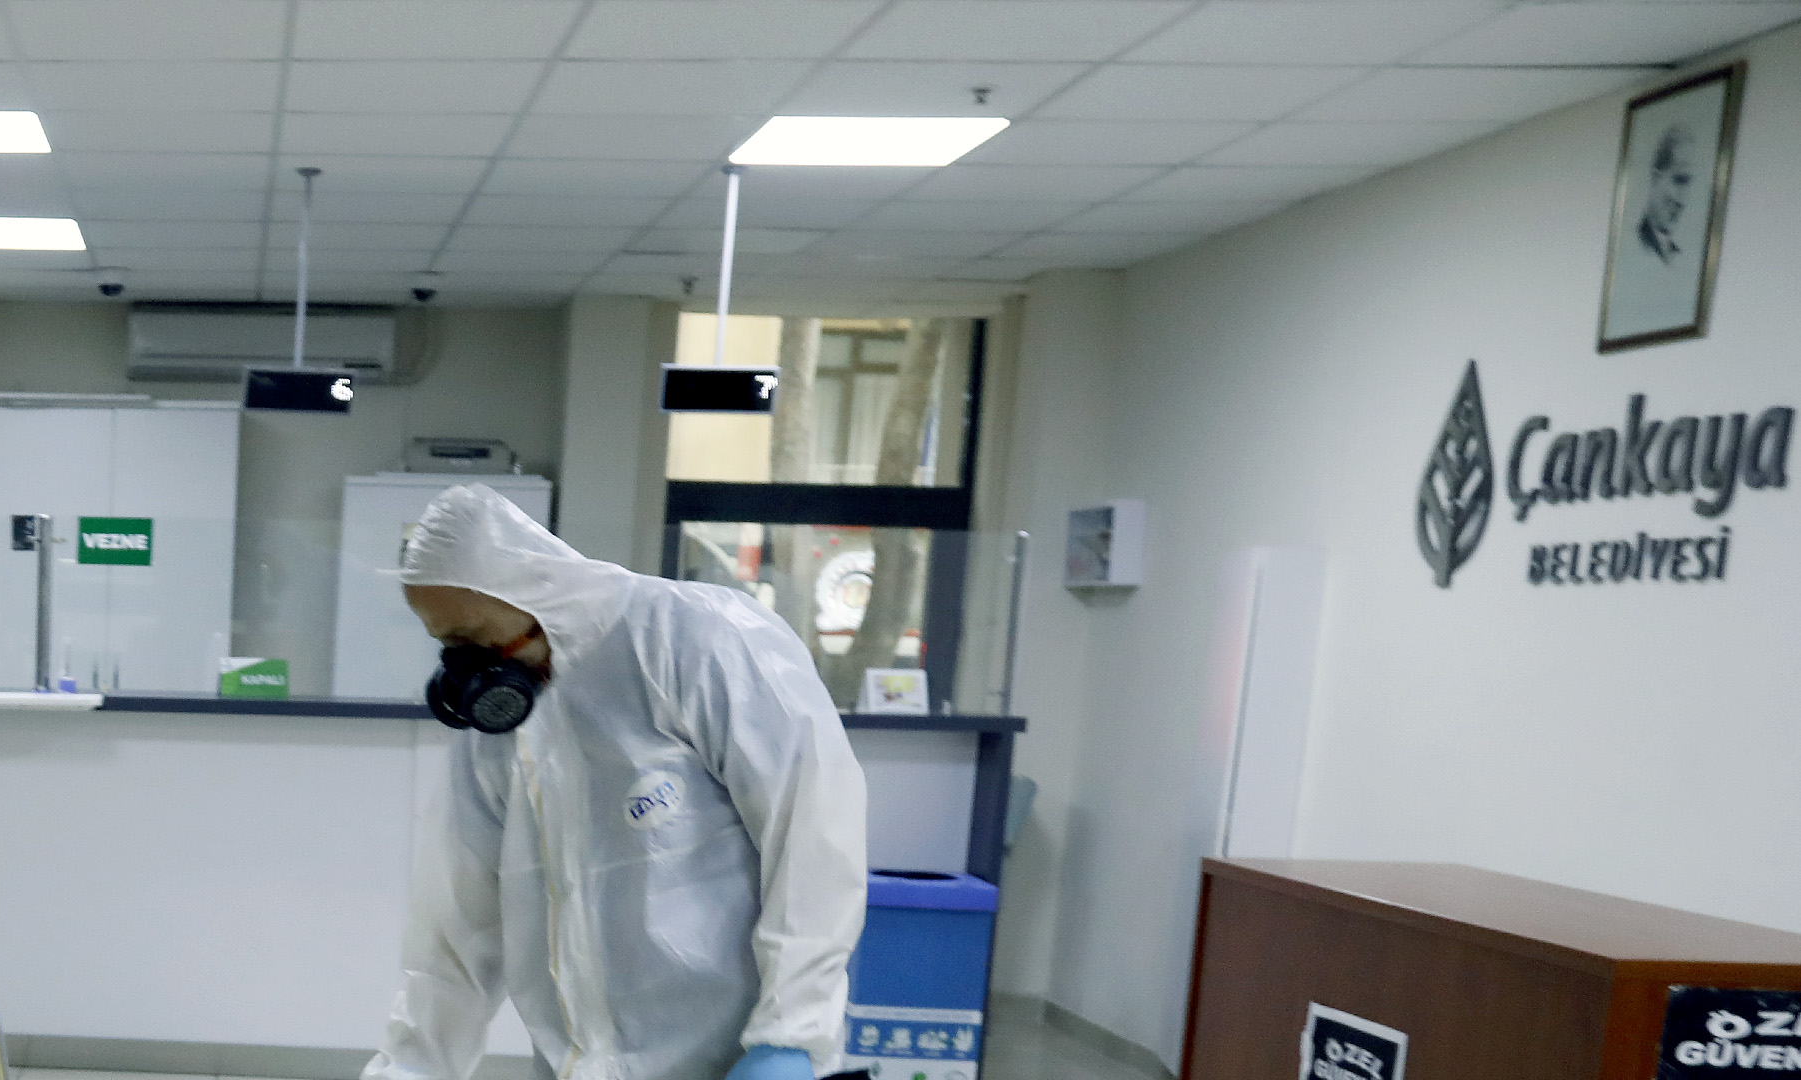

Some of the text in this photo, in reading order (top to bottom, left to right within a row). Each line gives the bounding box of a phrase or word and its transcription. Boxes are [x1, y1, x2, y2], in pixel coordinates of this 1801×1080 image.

[330, 378, 354, 401] 6
[754, 374, 779, 400] 7
[1507, 392, 1796, 519] Çankaya
[81, 532, 149, 550] VEZNE
[1528, 524, 1733, 587] BELEDİYESİ
